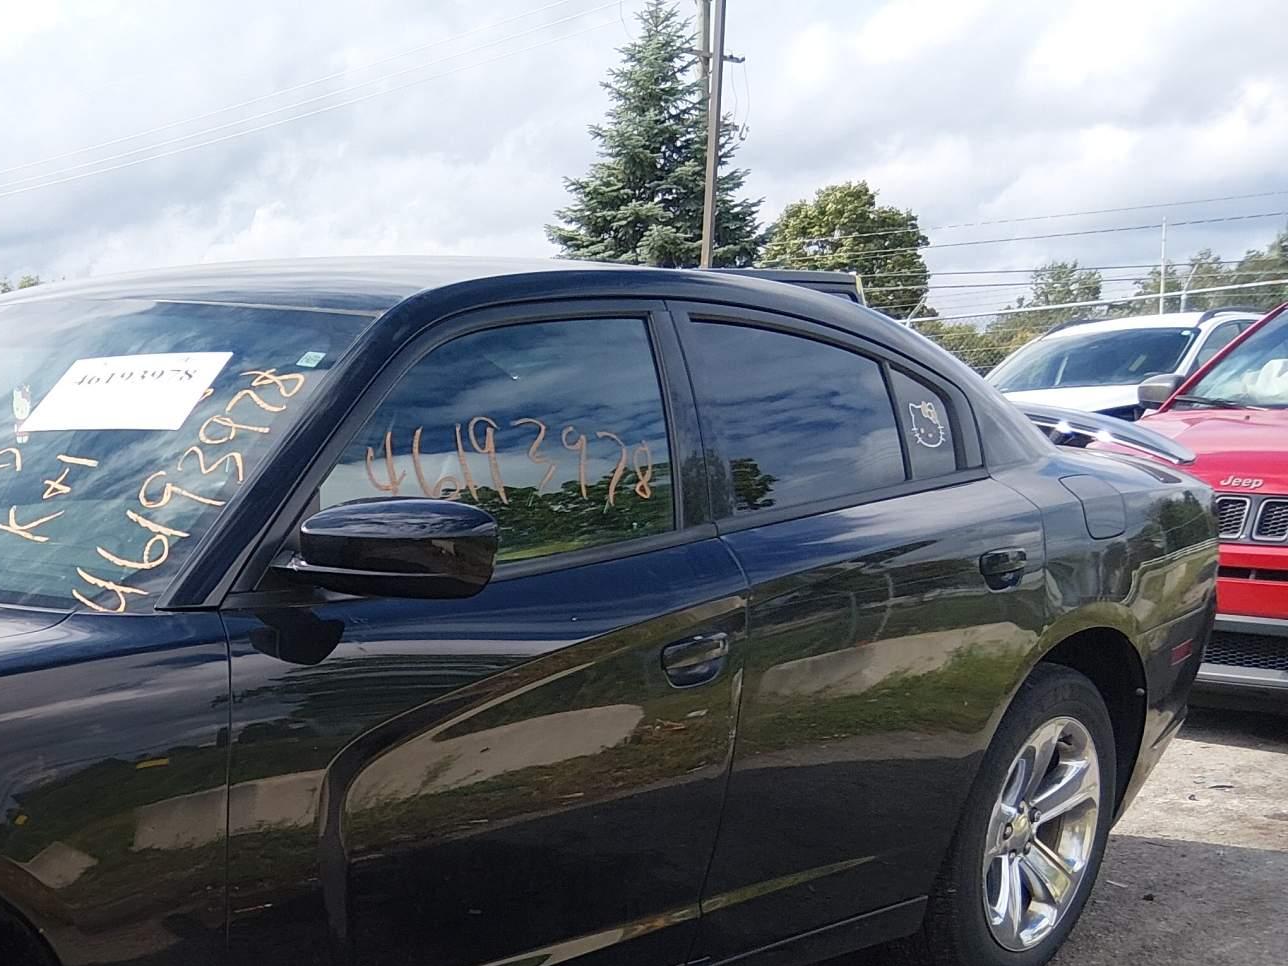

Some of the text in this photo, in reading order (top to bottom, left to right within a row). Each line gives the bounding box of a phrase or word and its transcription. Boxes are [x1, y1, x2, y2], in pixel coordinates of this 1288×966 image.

[73, 368, 198, 387] 46193978
[366, 416, 653, 507] 46193978
[1219, 475, 1264, 489] Jeep
[72, 367, 305, 613] 46193978
